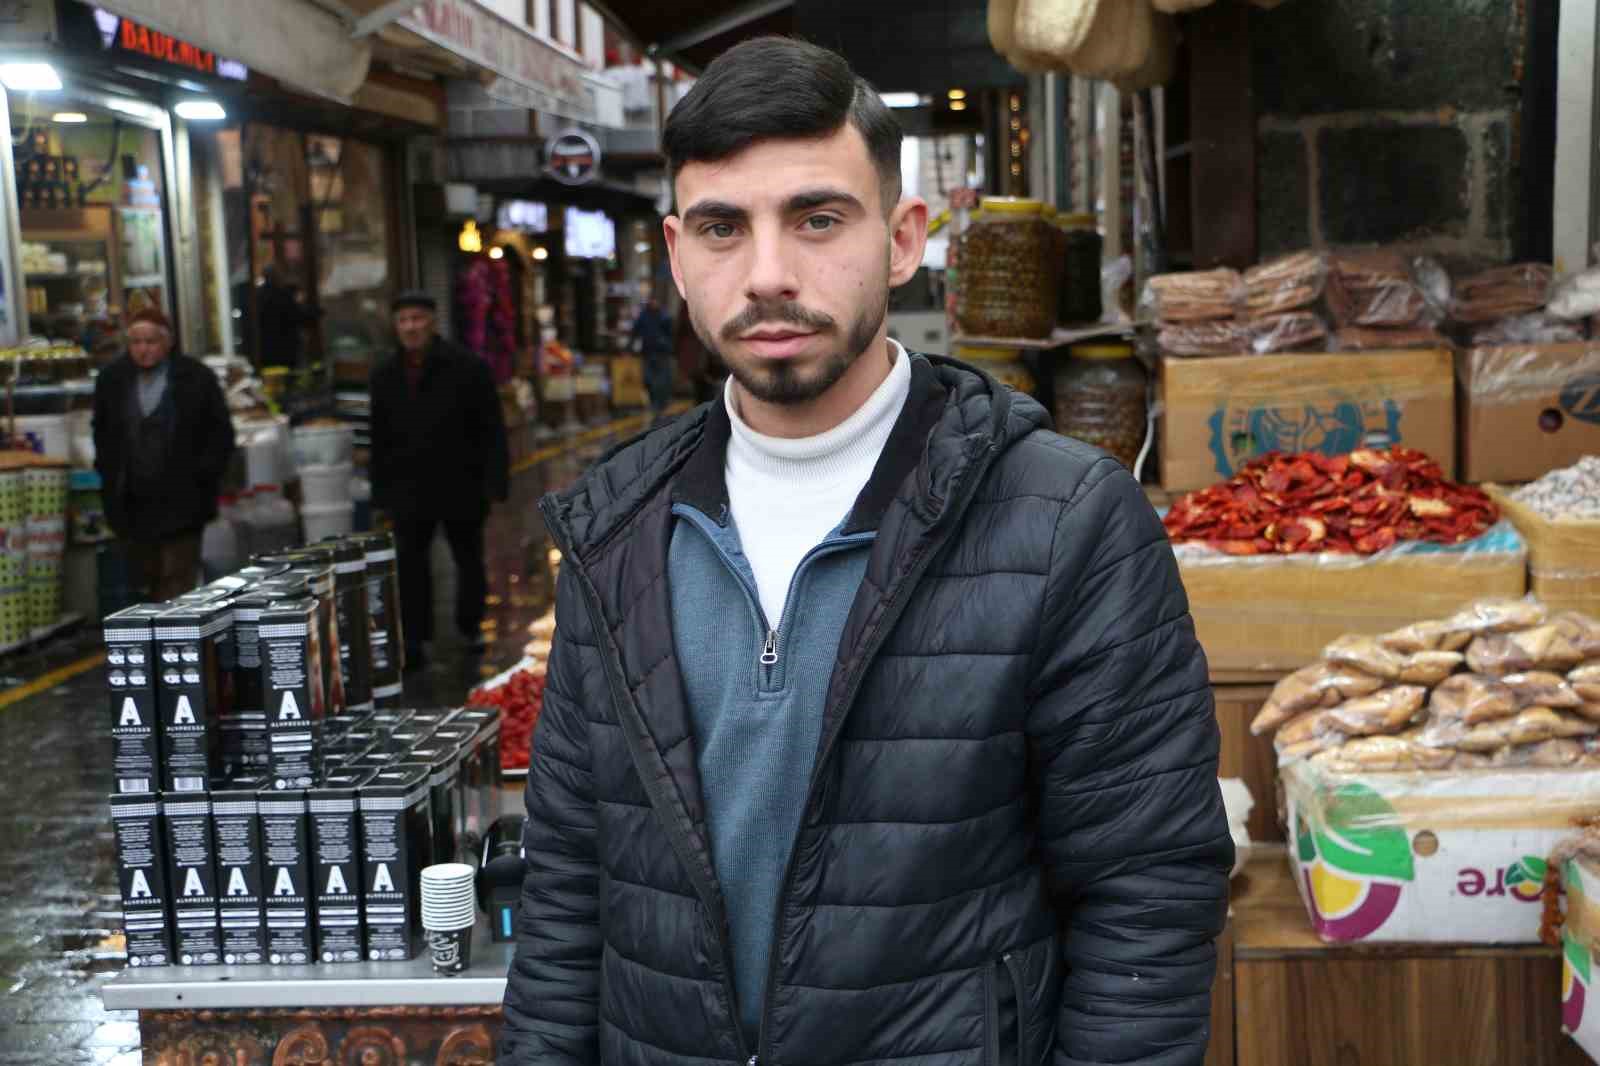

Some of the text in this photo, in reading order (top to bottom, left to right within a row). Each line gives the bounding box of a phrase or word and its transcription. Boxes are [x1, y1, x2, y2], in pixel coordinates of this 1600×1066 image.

[120, 697, 141, 725] A
[174, 696, 195, 723] A
[279, 691, 301, 719] A
[131, 870, 152, 897] A
[184, 868, 204, 896] A
[228, 868, 248, 895] A
[274, 867, 295, 895] A
[326, 866, 347, 893] A
[373, 863, 394, 891] A
